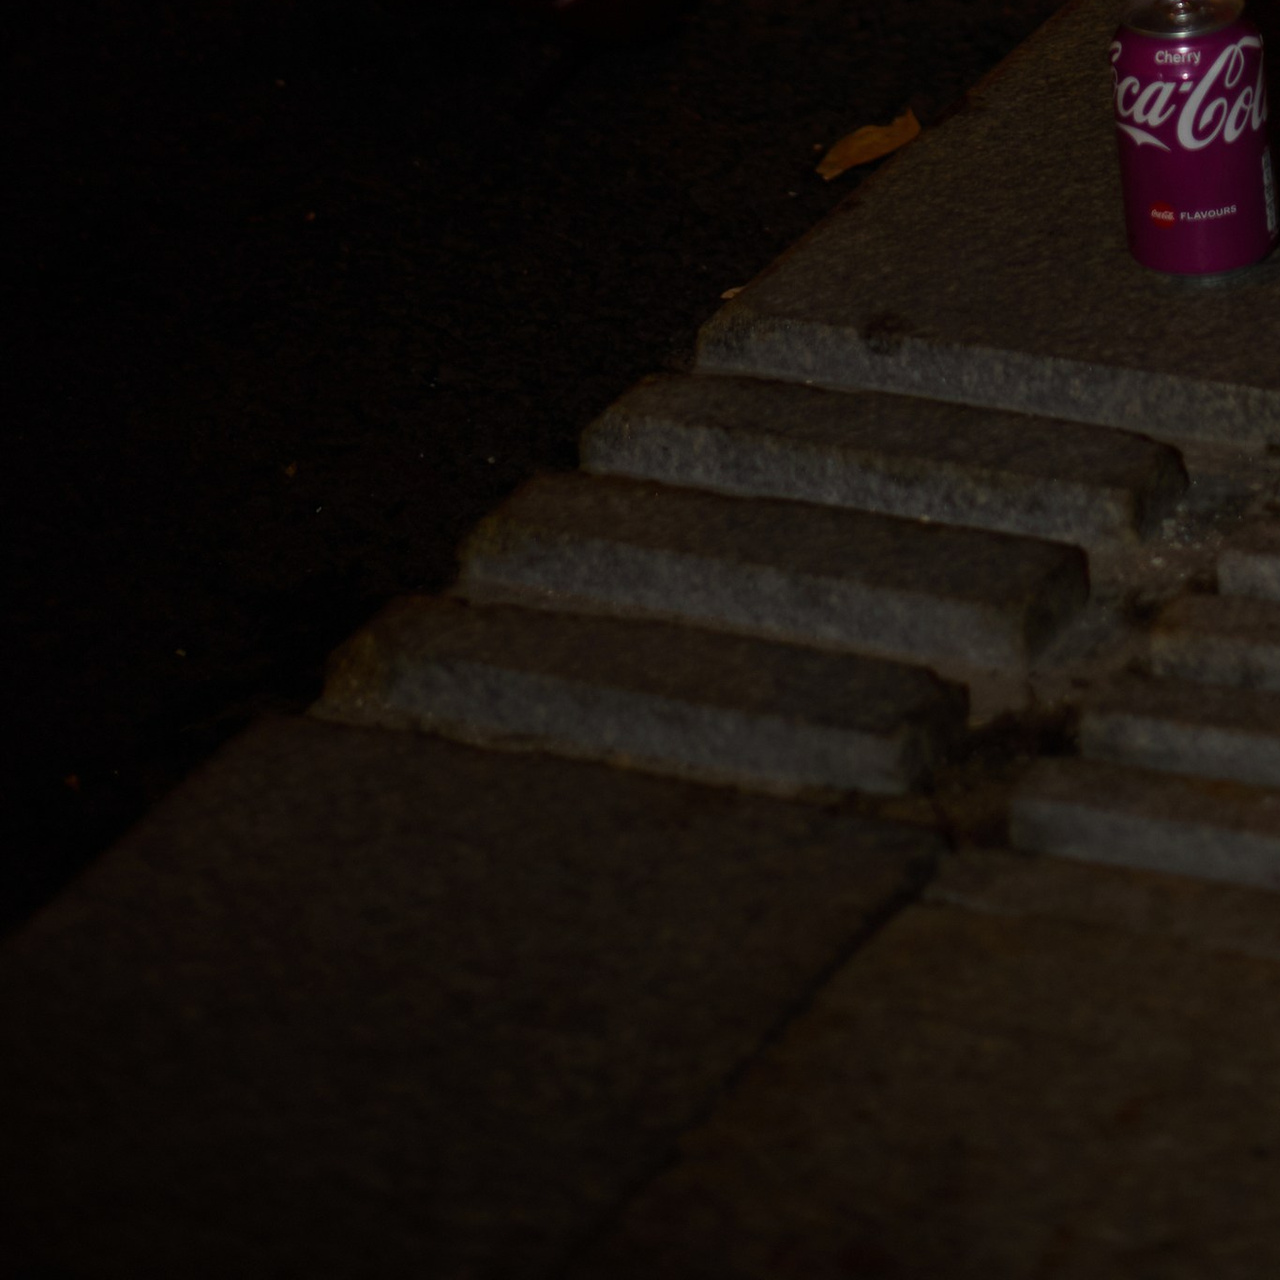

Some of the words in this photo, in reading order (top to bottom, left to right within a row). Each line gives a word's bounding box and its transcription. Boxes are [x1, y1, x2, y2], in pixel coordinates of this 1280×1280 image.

[1154, 49, 1202, 65] Cherry
[1109, 34, 1268, 152] ca-Col
[1180, 204, 1237, 221] FLAVOURS
